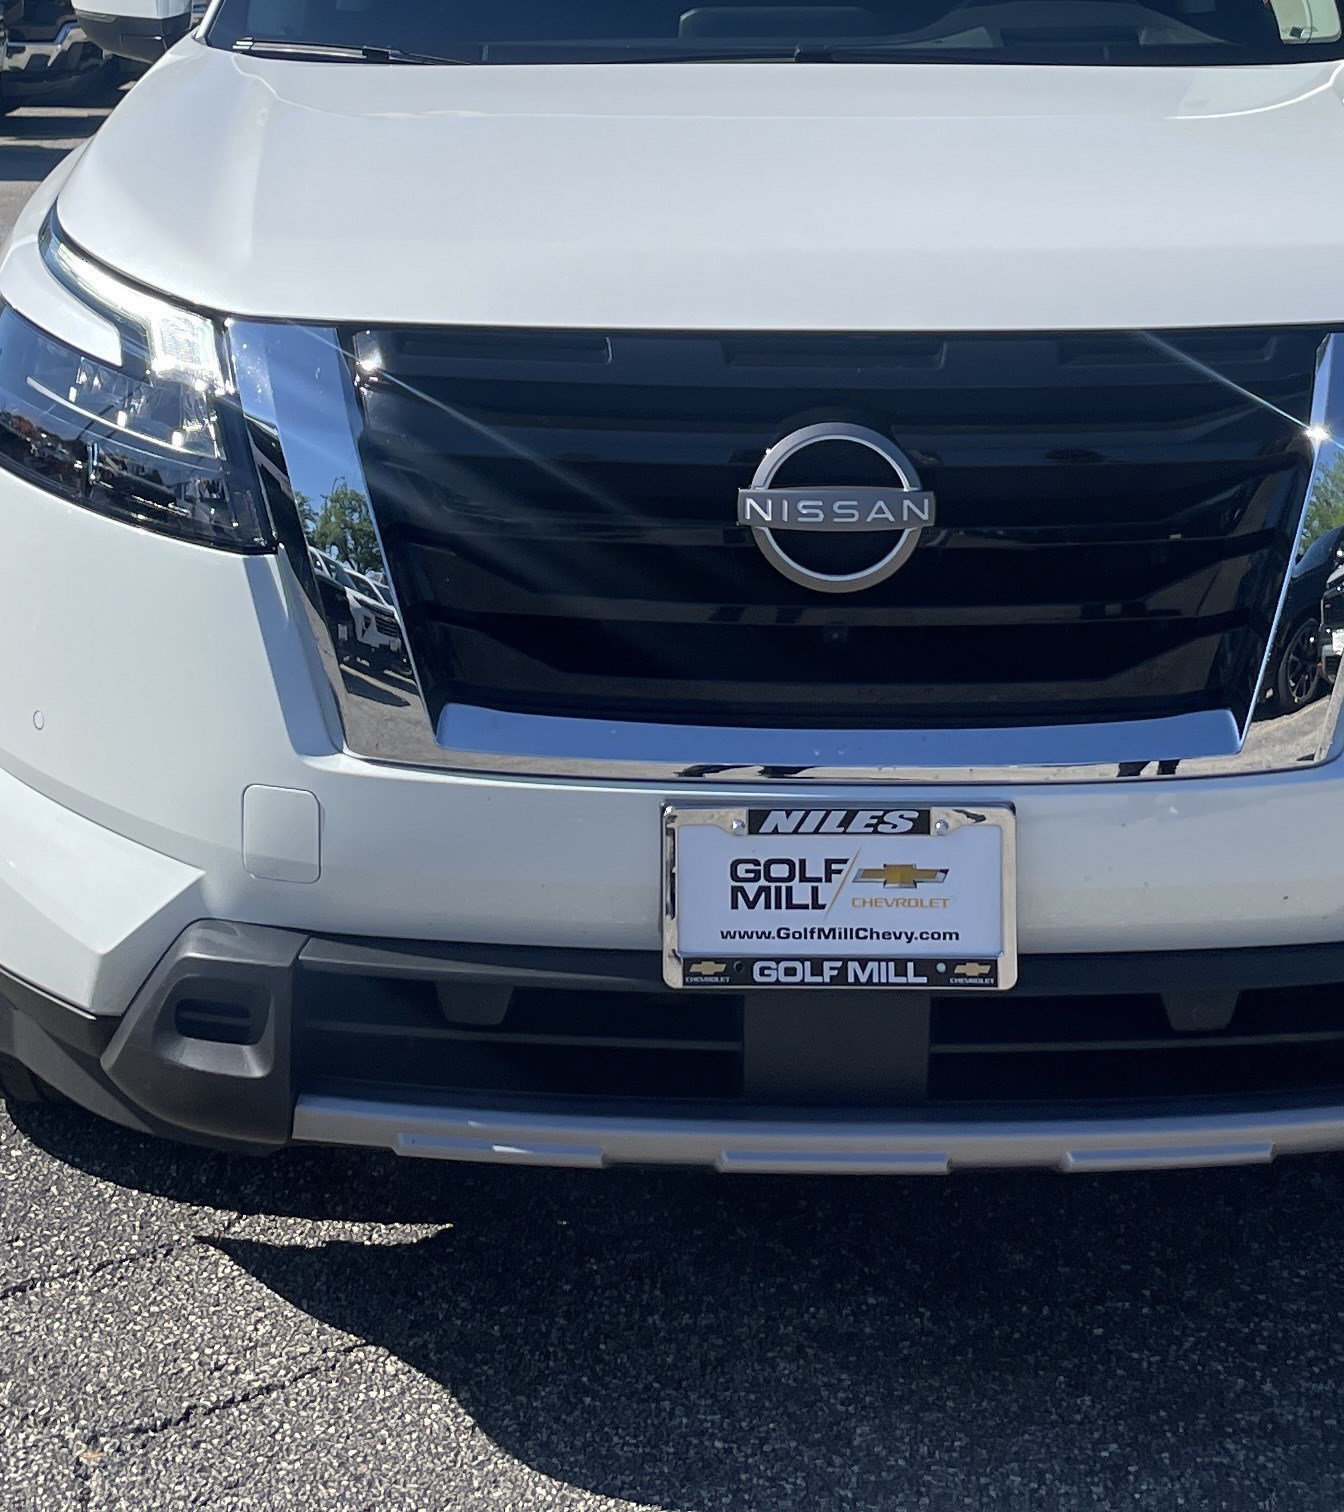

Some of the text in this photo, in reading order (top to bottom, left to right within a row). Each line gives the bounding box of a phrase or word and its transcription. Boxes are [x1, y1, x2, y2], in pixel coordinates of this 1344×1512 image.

[744, 497, 930, 523] NISSAN
[758, 809, 920, 834] NILES
[729, 857, 850, 883] GOLF
[730, 885, 827, 910] MILL
[851, 897, 951, 909] CHEVROLET
[720, 927, 960, 944] www.GolfMillChevy.com
[752, 960, 928, 984] GOLF MILL
